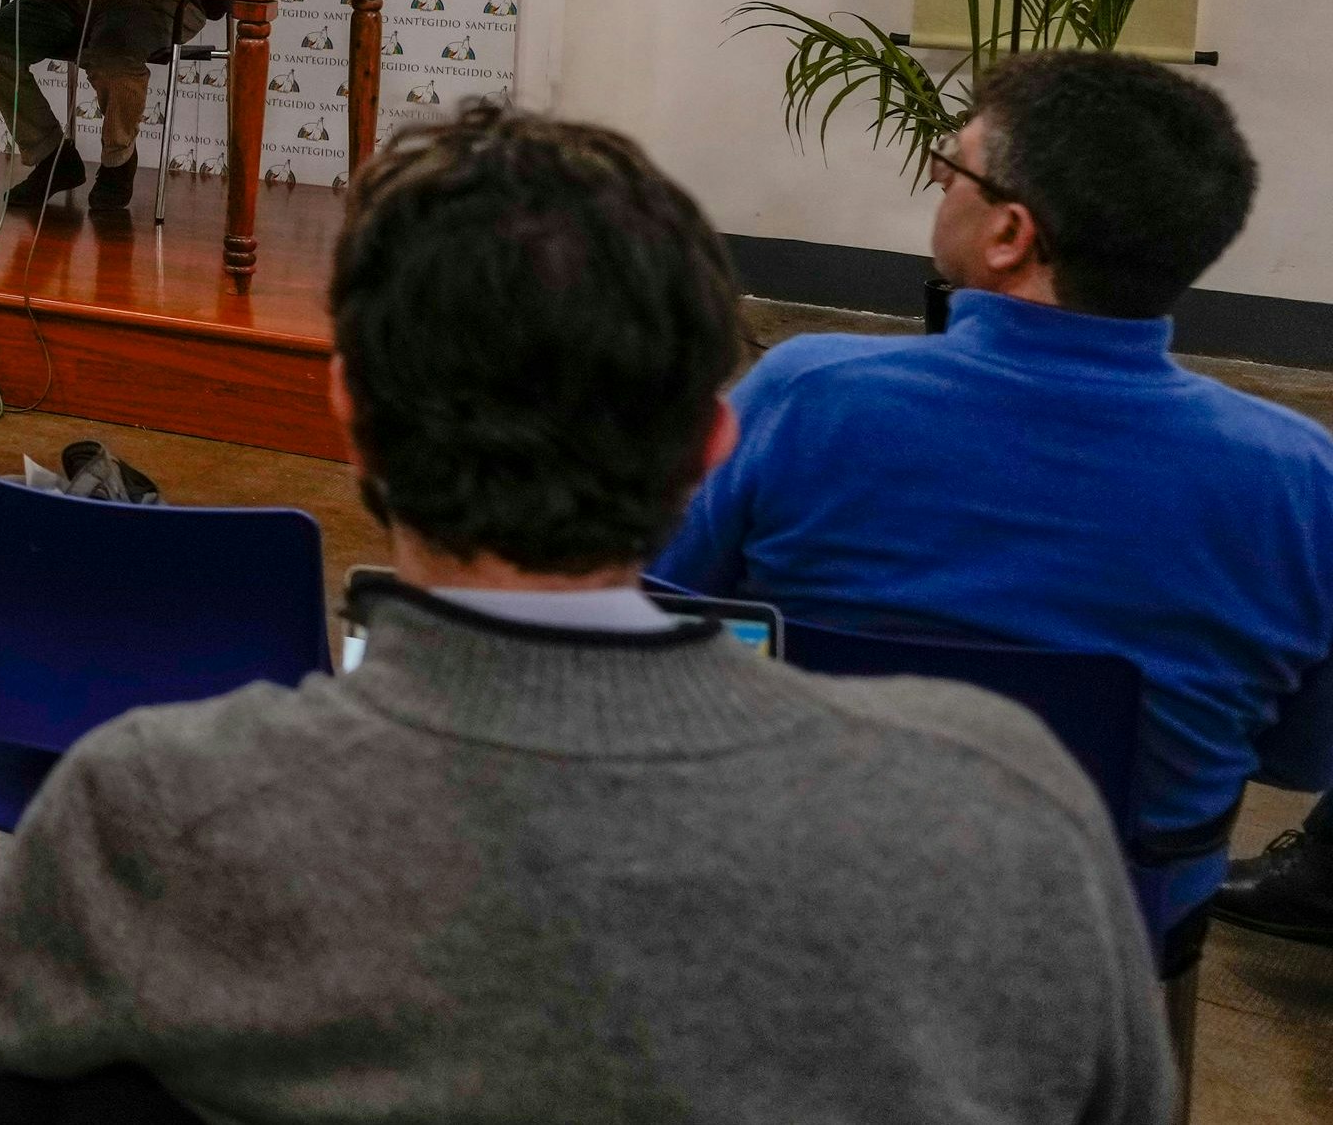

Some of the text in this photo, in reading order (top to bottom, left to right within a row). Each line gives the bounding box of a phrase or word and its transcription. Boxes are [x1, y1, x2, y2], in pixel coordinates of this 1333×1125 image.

[393, 16, 460, 29] SANT'EGIDIO
[285, 54, 349, 67] SANT'EGIDIO
[424, 65, 492, 78] SANT'EGIDIO
[280, 144, 345, 158] SANT'EGIDIO
